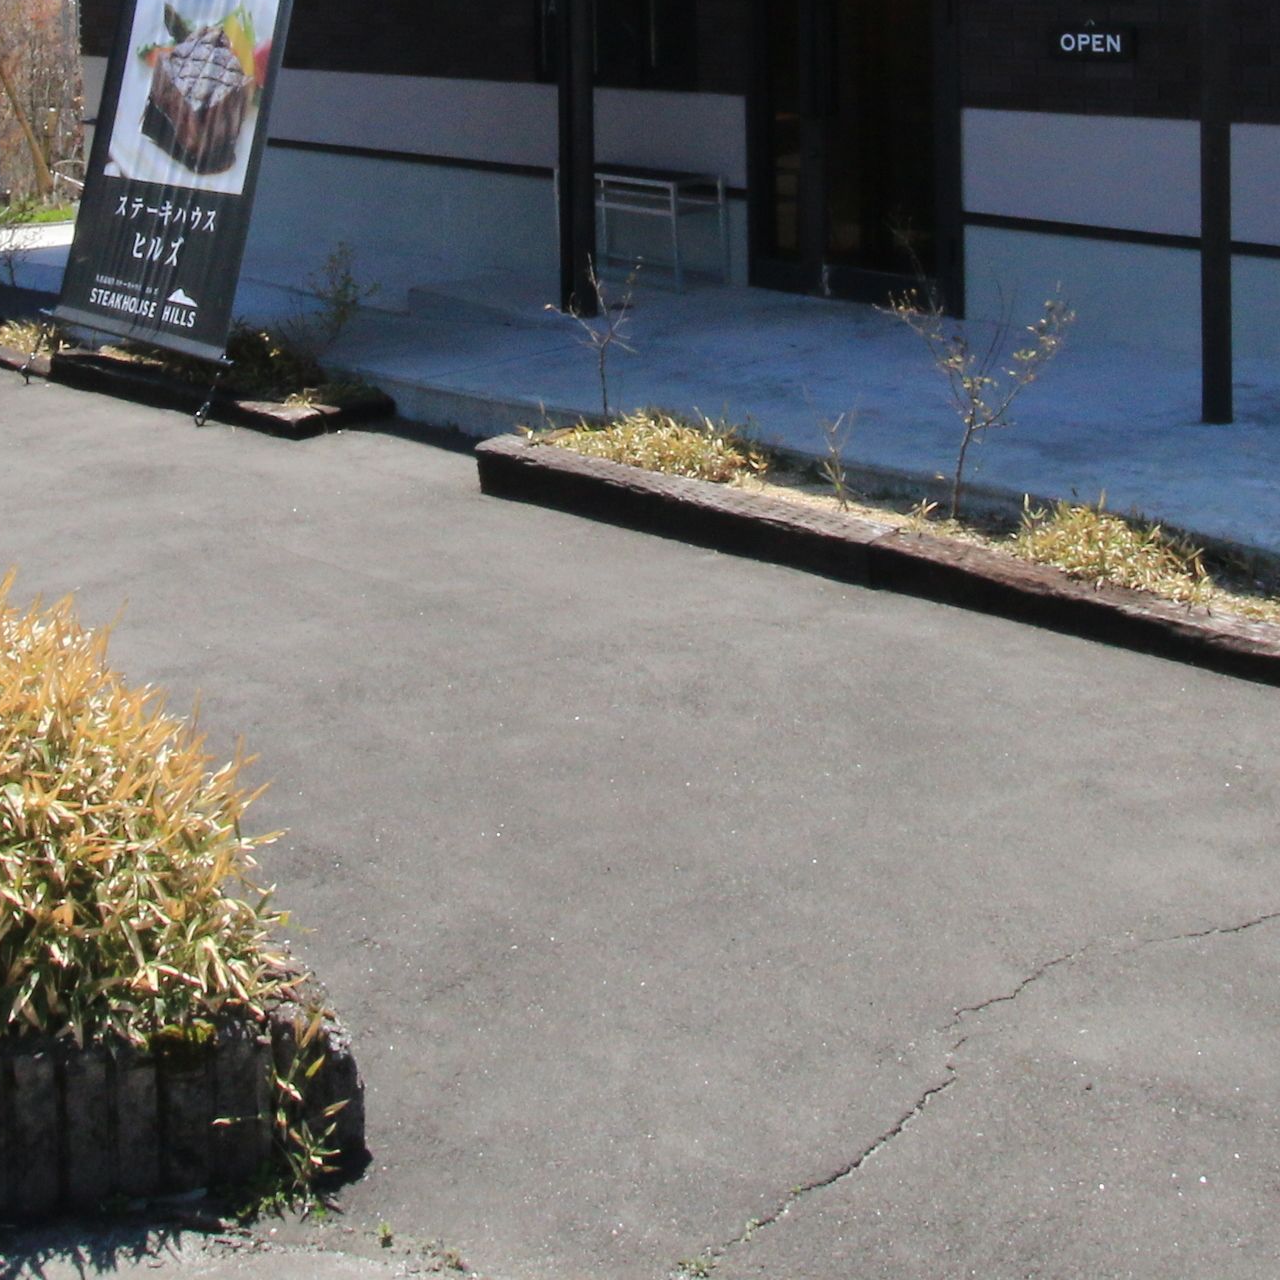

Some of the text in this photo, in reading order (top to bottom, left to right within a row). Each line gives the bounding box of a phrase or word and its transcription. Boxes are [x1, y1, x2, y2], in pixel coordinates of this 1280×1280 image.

[1059, 32, 1122, 53] OPEN
[114, 195, 217, 233] ステーキハウス
[132, 231, 185, 268] ヒルズ
[88, 287, 197, 329] STEAKHOUSE HILLS
